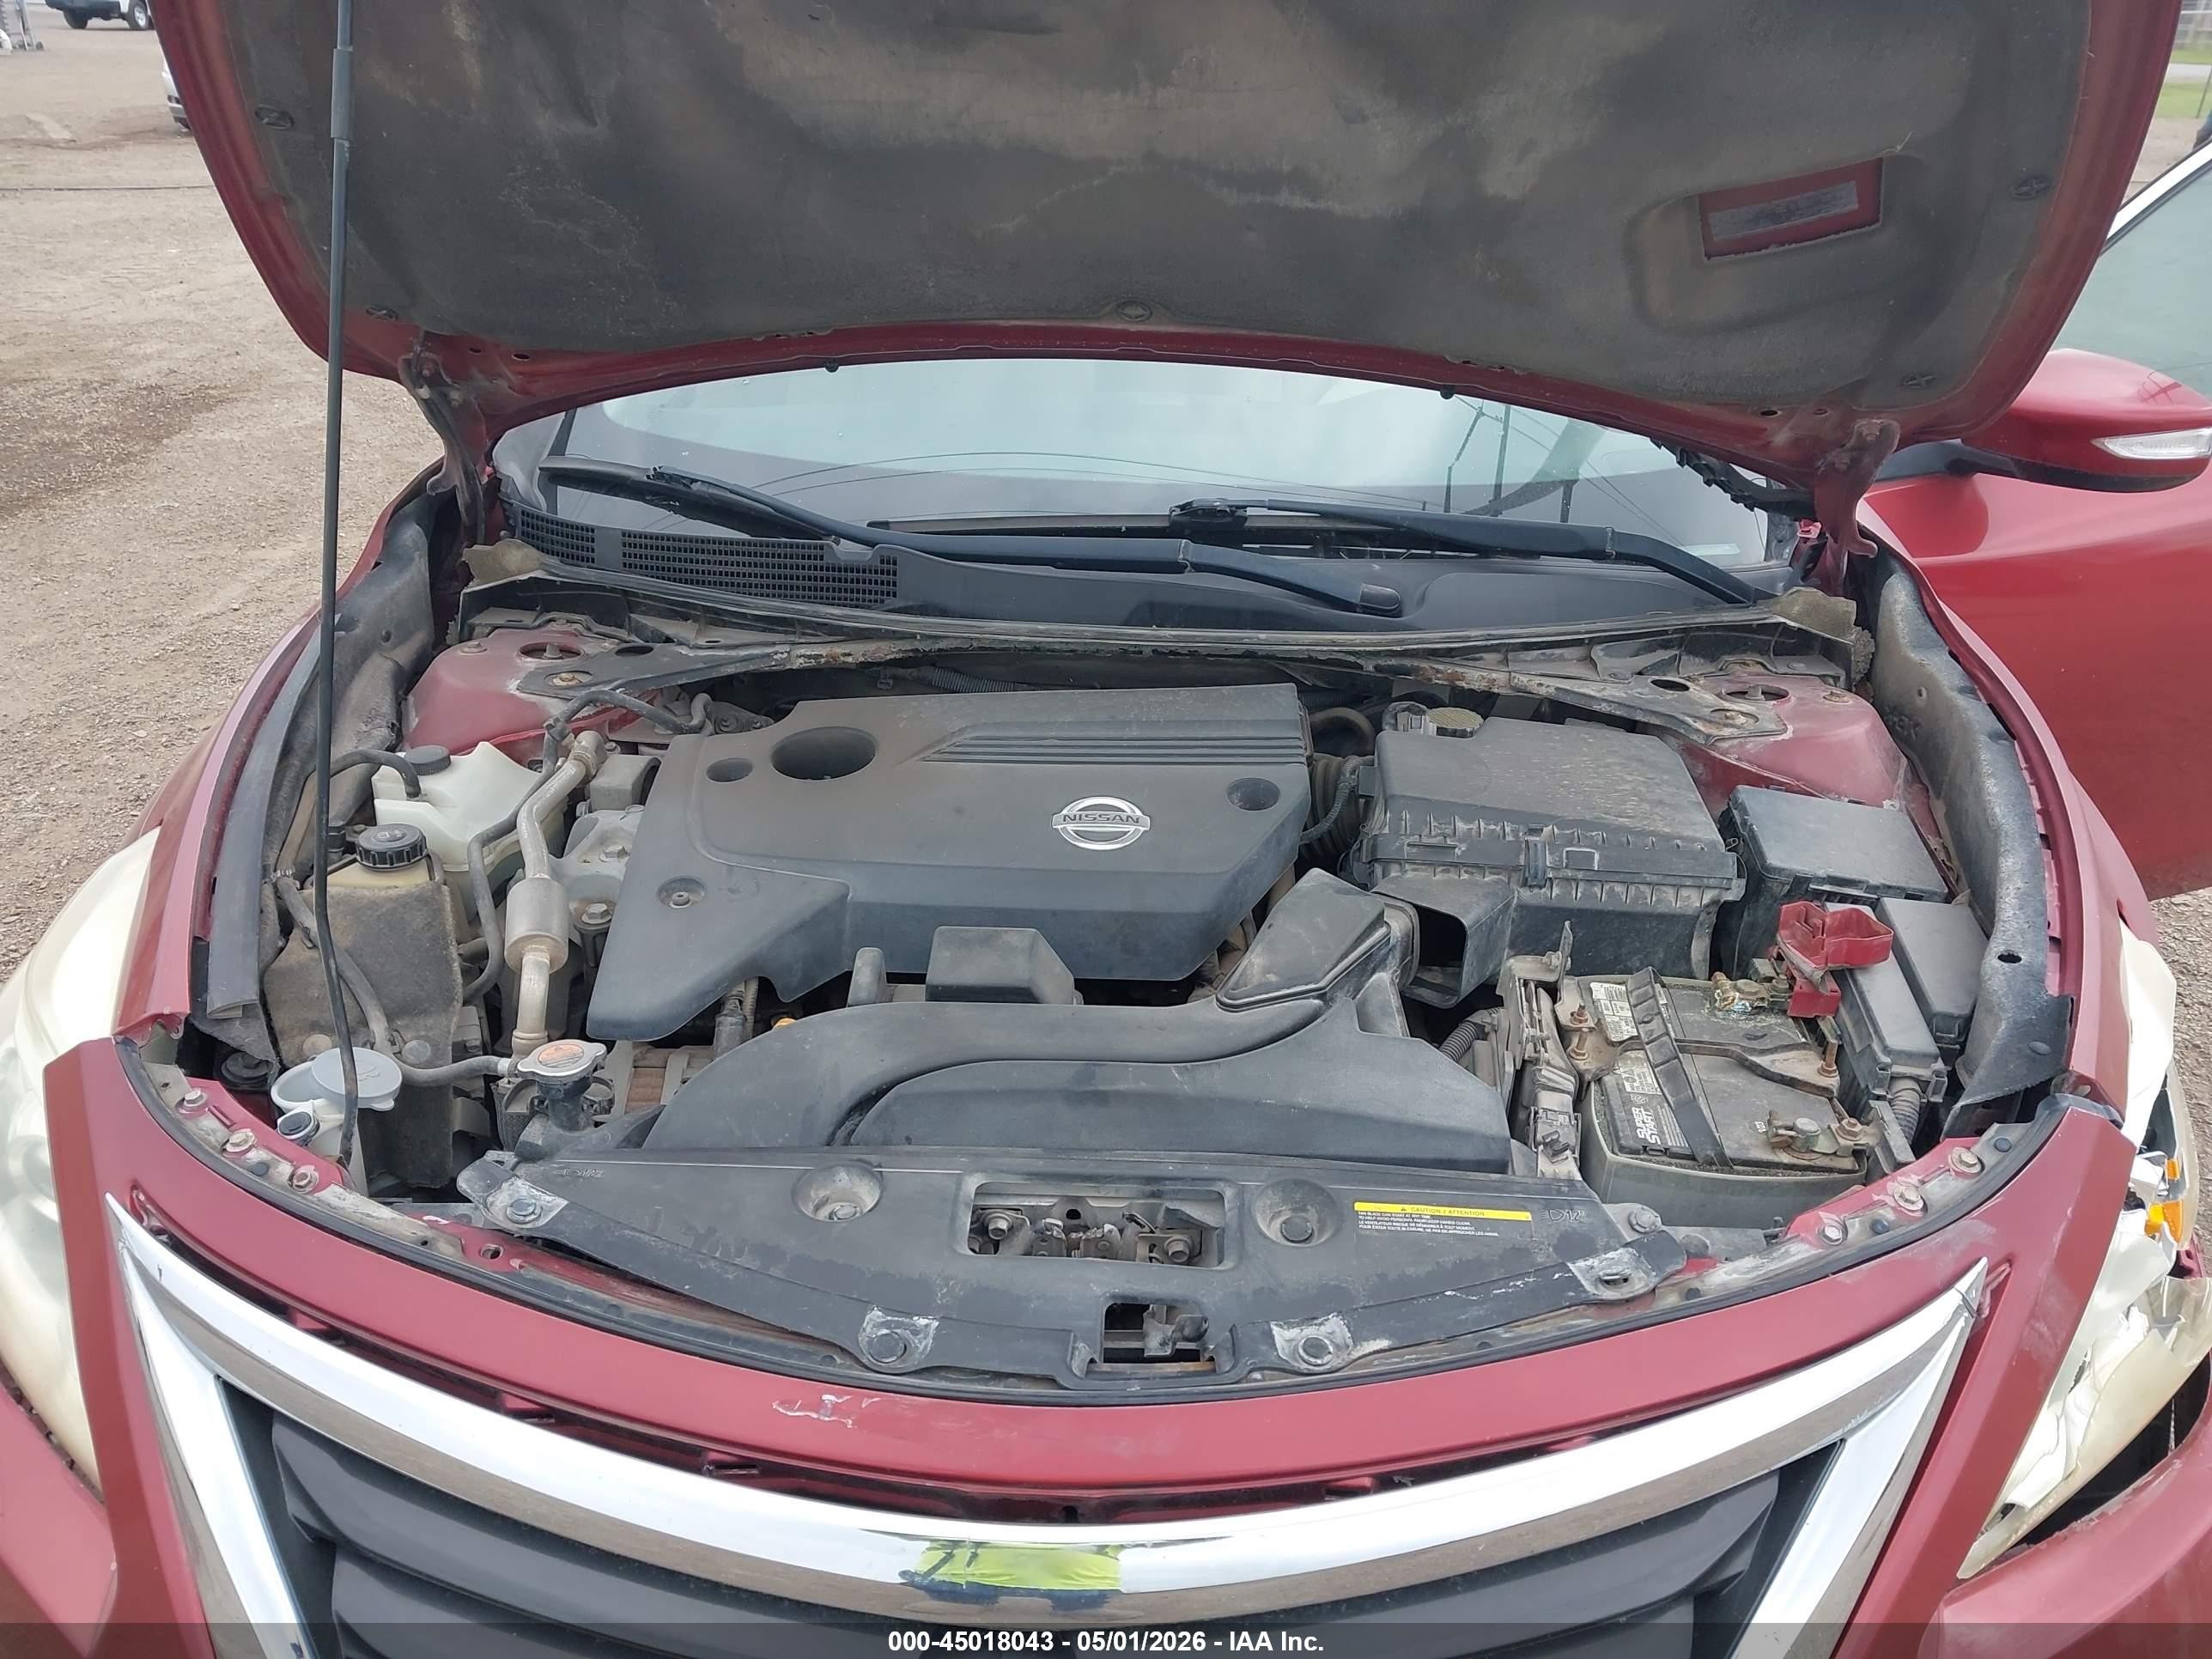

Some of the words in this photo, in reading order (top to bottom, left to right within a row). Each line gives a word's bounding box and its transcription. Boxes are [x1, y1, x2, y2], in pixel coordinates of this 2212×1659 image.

[1062, 813, 1139, 823] NISSAN
[1632, 1107, 1647, 1139] SUPER
[1640, 1106, 1661, 1146] START
